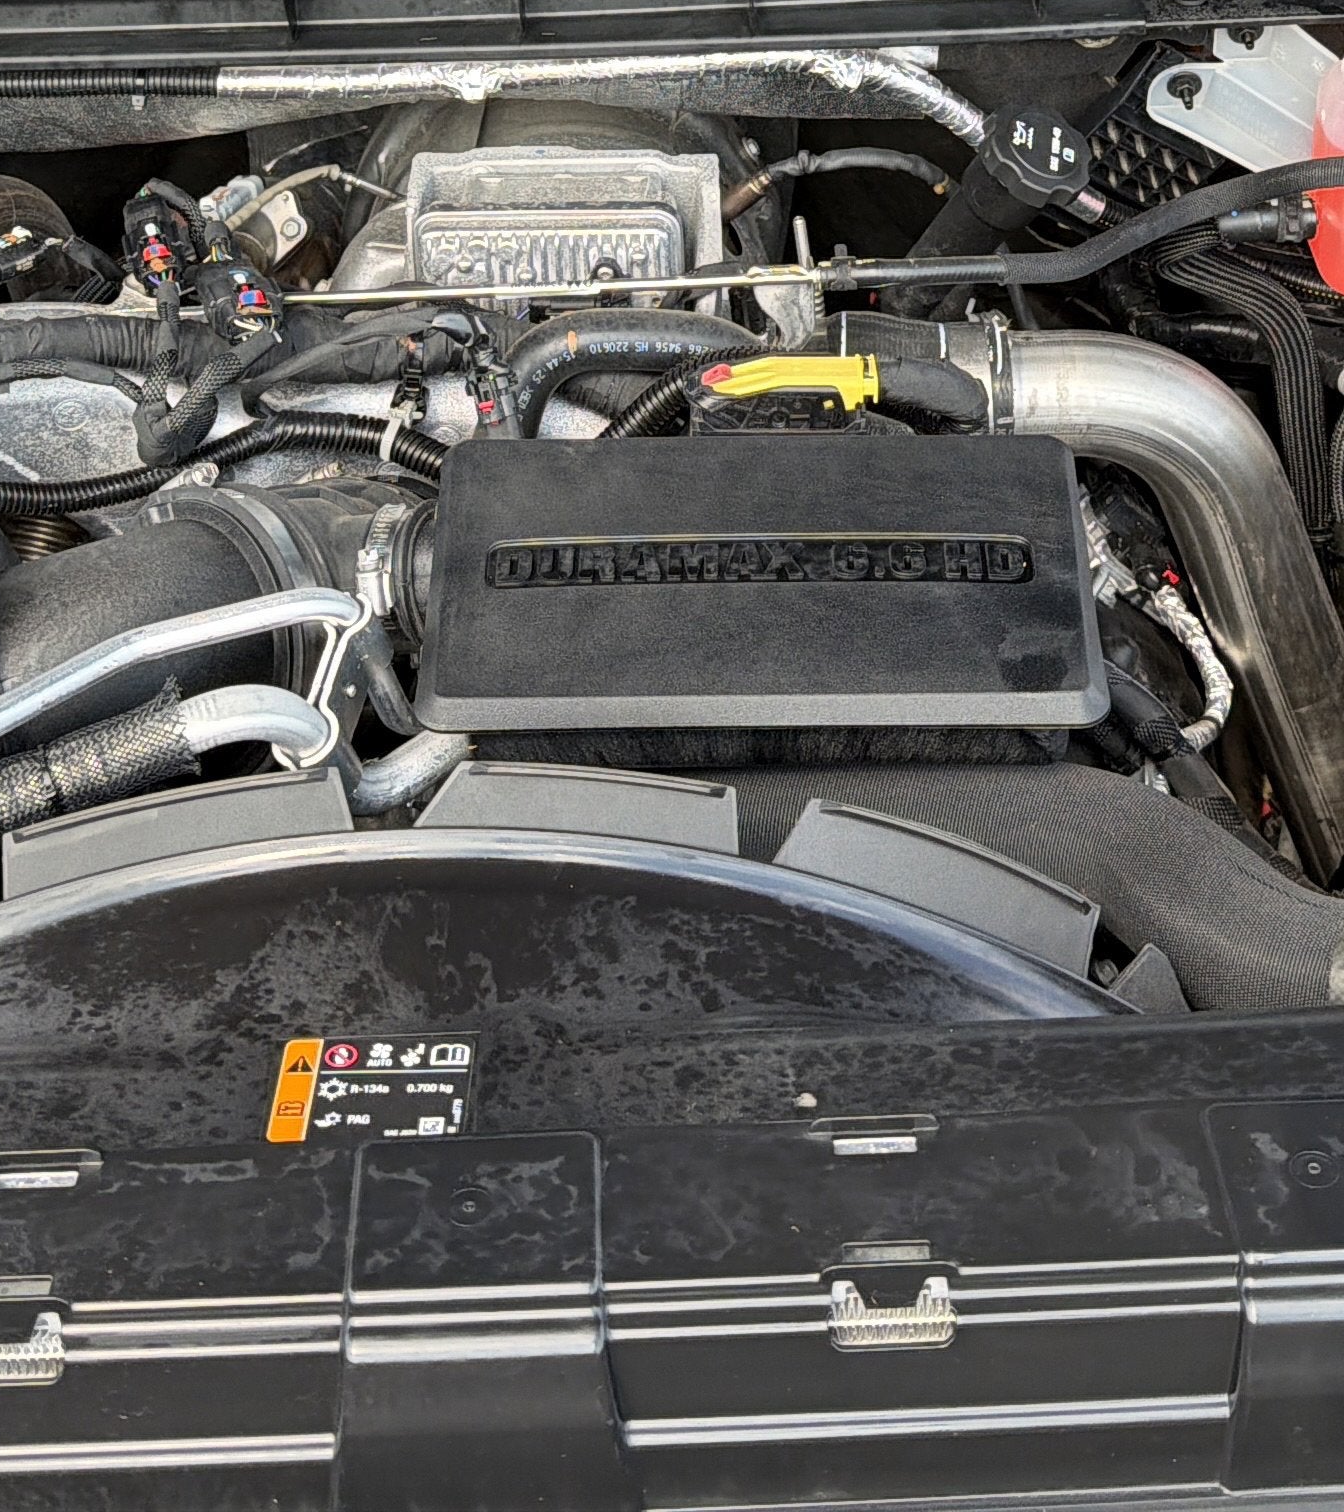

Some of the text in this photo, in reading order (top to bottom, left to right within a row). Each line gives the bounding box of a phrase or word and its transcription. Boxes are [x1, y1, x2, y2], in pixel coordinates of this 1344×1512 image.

[589, 342, 629, 355] 220610
[634, 342, 649, 353] HS
[655, 342, 682, 353] 9456
[688, 343, 714, 355] 266
[494, 540, 1031, 587] DURAMAX 6.6 HD
[366, 1058, 393, 1068] AUTO
[349, 1083, 454, 1095] R-134a 0.700 kg
[346, 1114, 371, 1125] PAG
